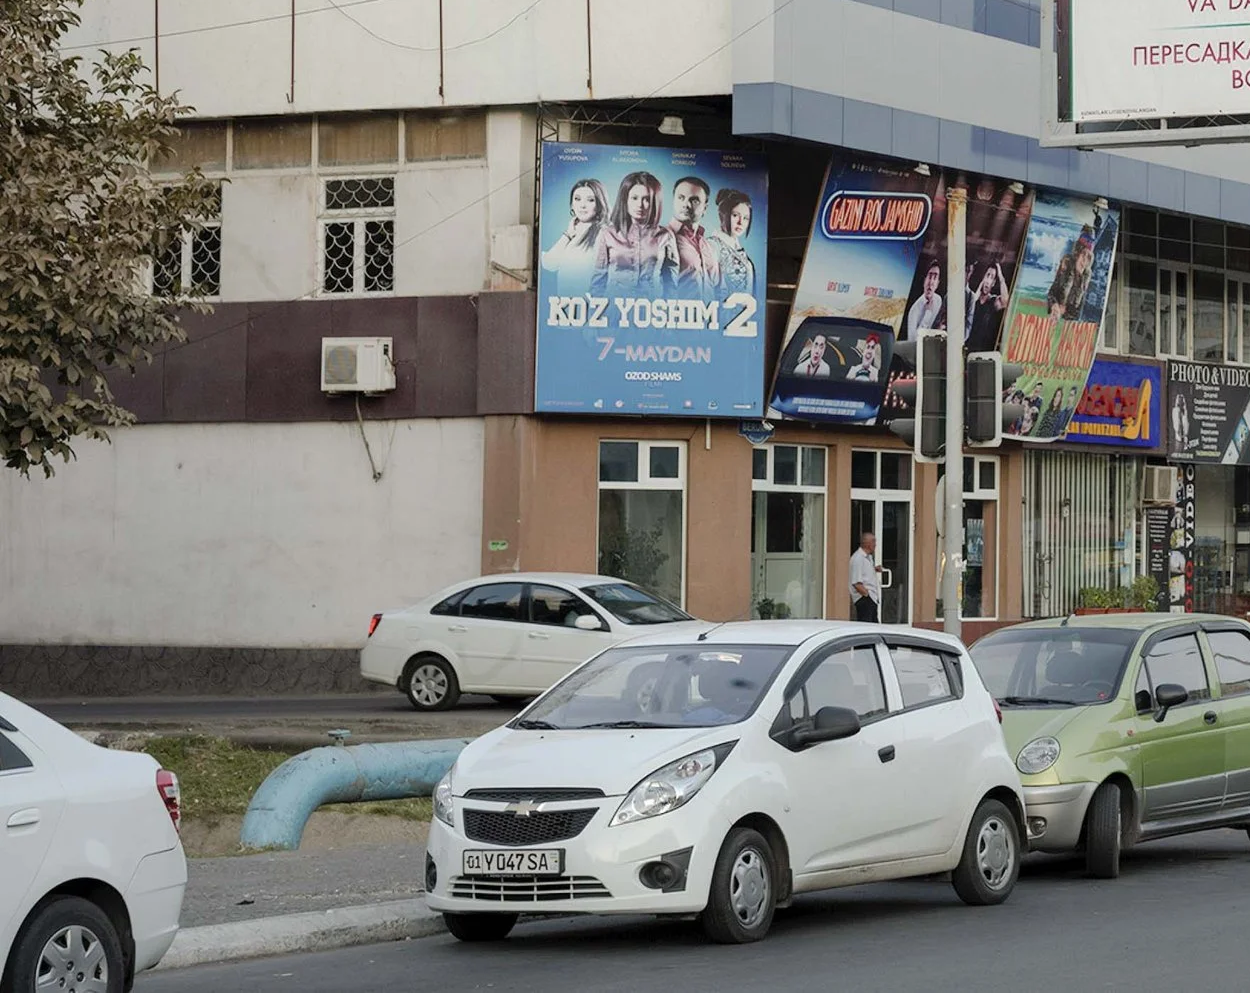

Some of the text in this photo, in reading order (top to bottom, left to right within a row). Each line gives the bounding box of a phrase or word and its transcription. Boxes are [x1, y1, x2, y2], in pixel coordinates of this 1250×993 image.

[615, 297, 720, 330] YOSHIM
[722, 292, 759, 338] 2
[596, 337, 711, 364] 7-MAYDAN
[650, 371, 682, 382] SHAMS
[466, 855, 481, 869] 01
